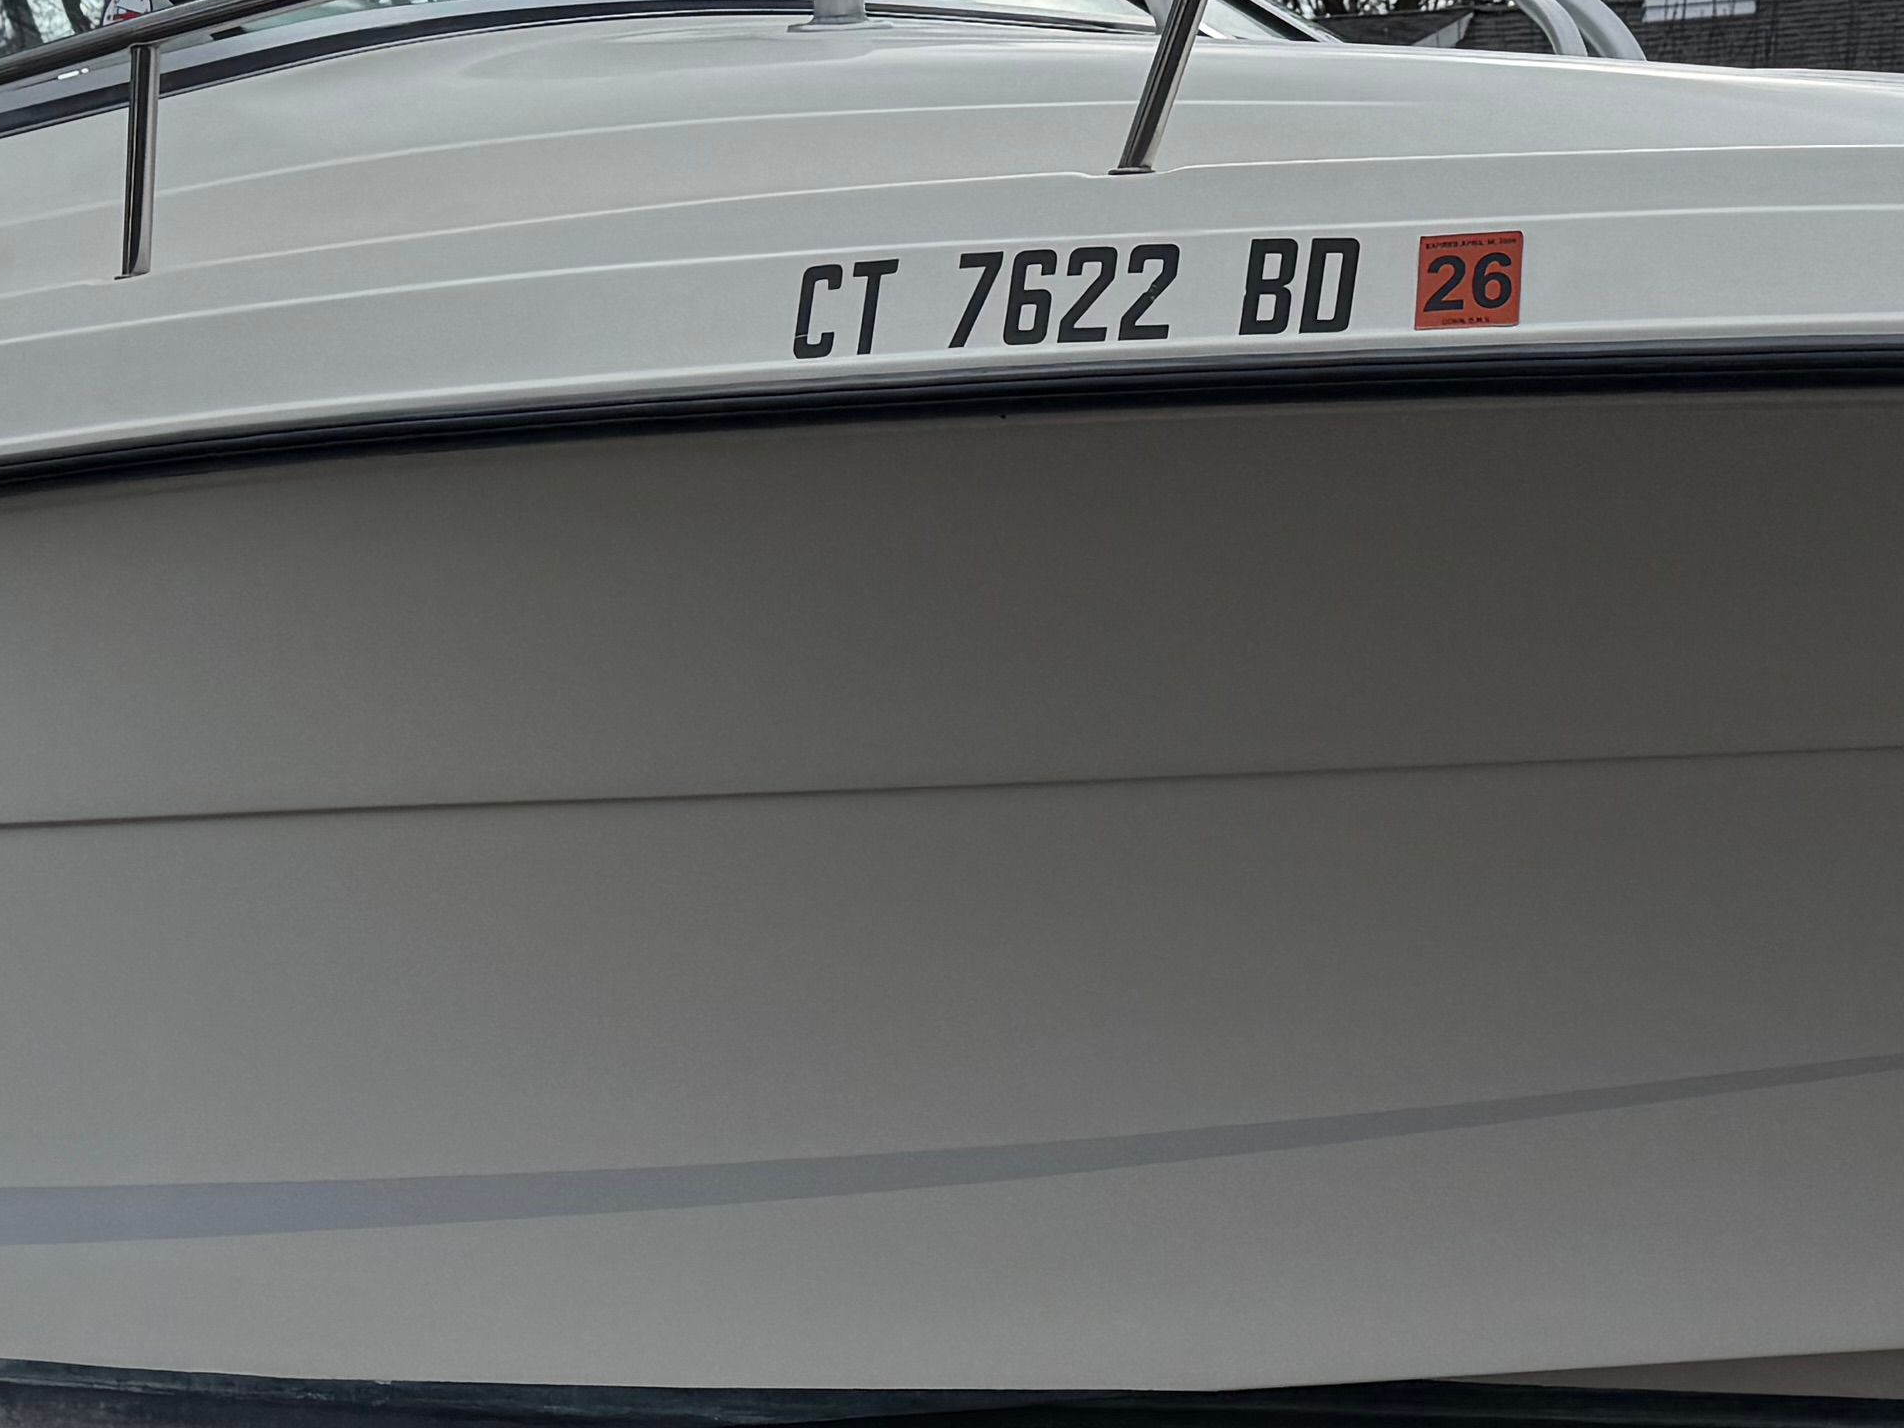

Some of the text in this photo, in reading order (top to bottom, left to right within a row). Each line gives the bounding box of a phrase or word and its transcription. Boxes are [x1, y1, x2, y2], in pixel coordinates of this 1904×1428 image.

[793, 237, 1361, 360] CT 7622 BD
[1423, 252, 1512, 312] 26
